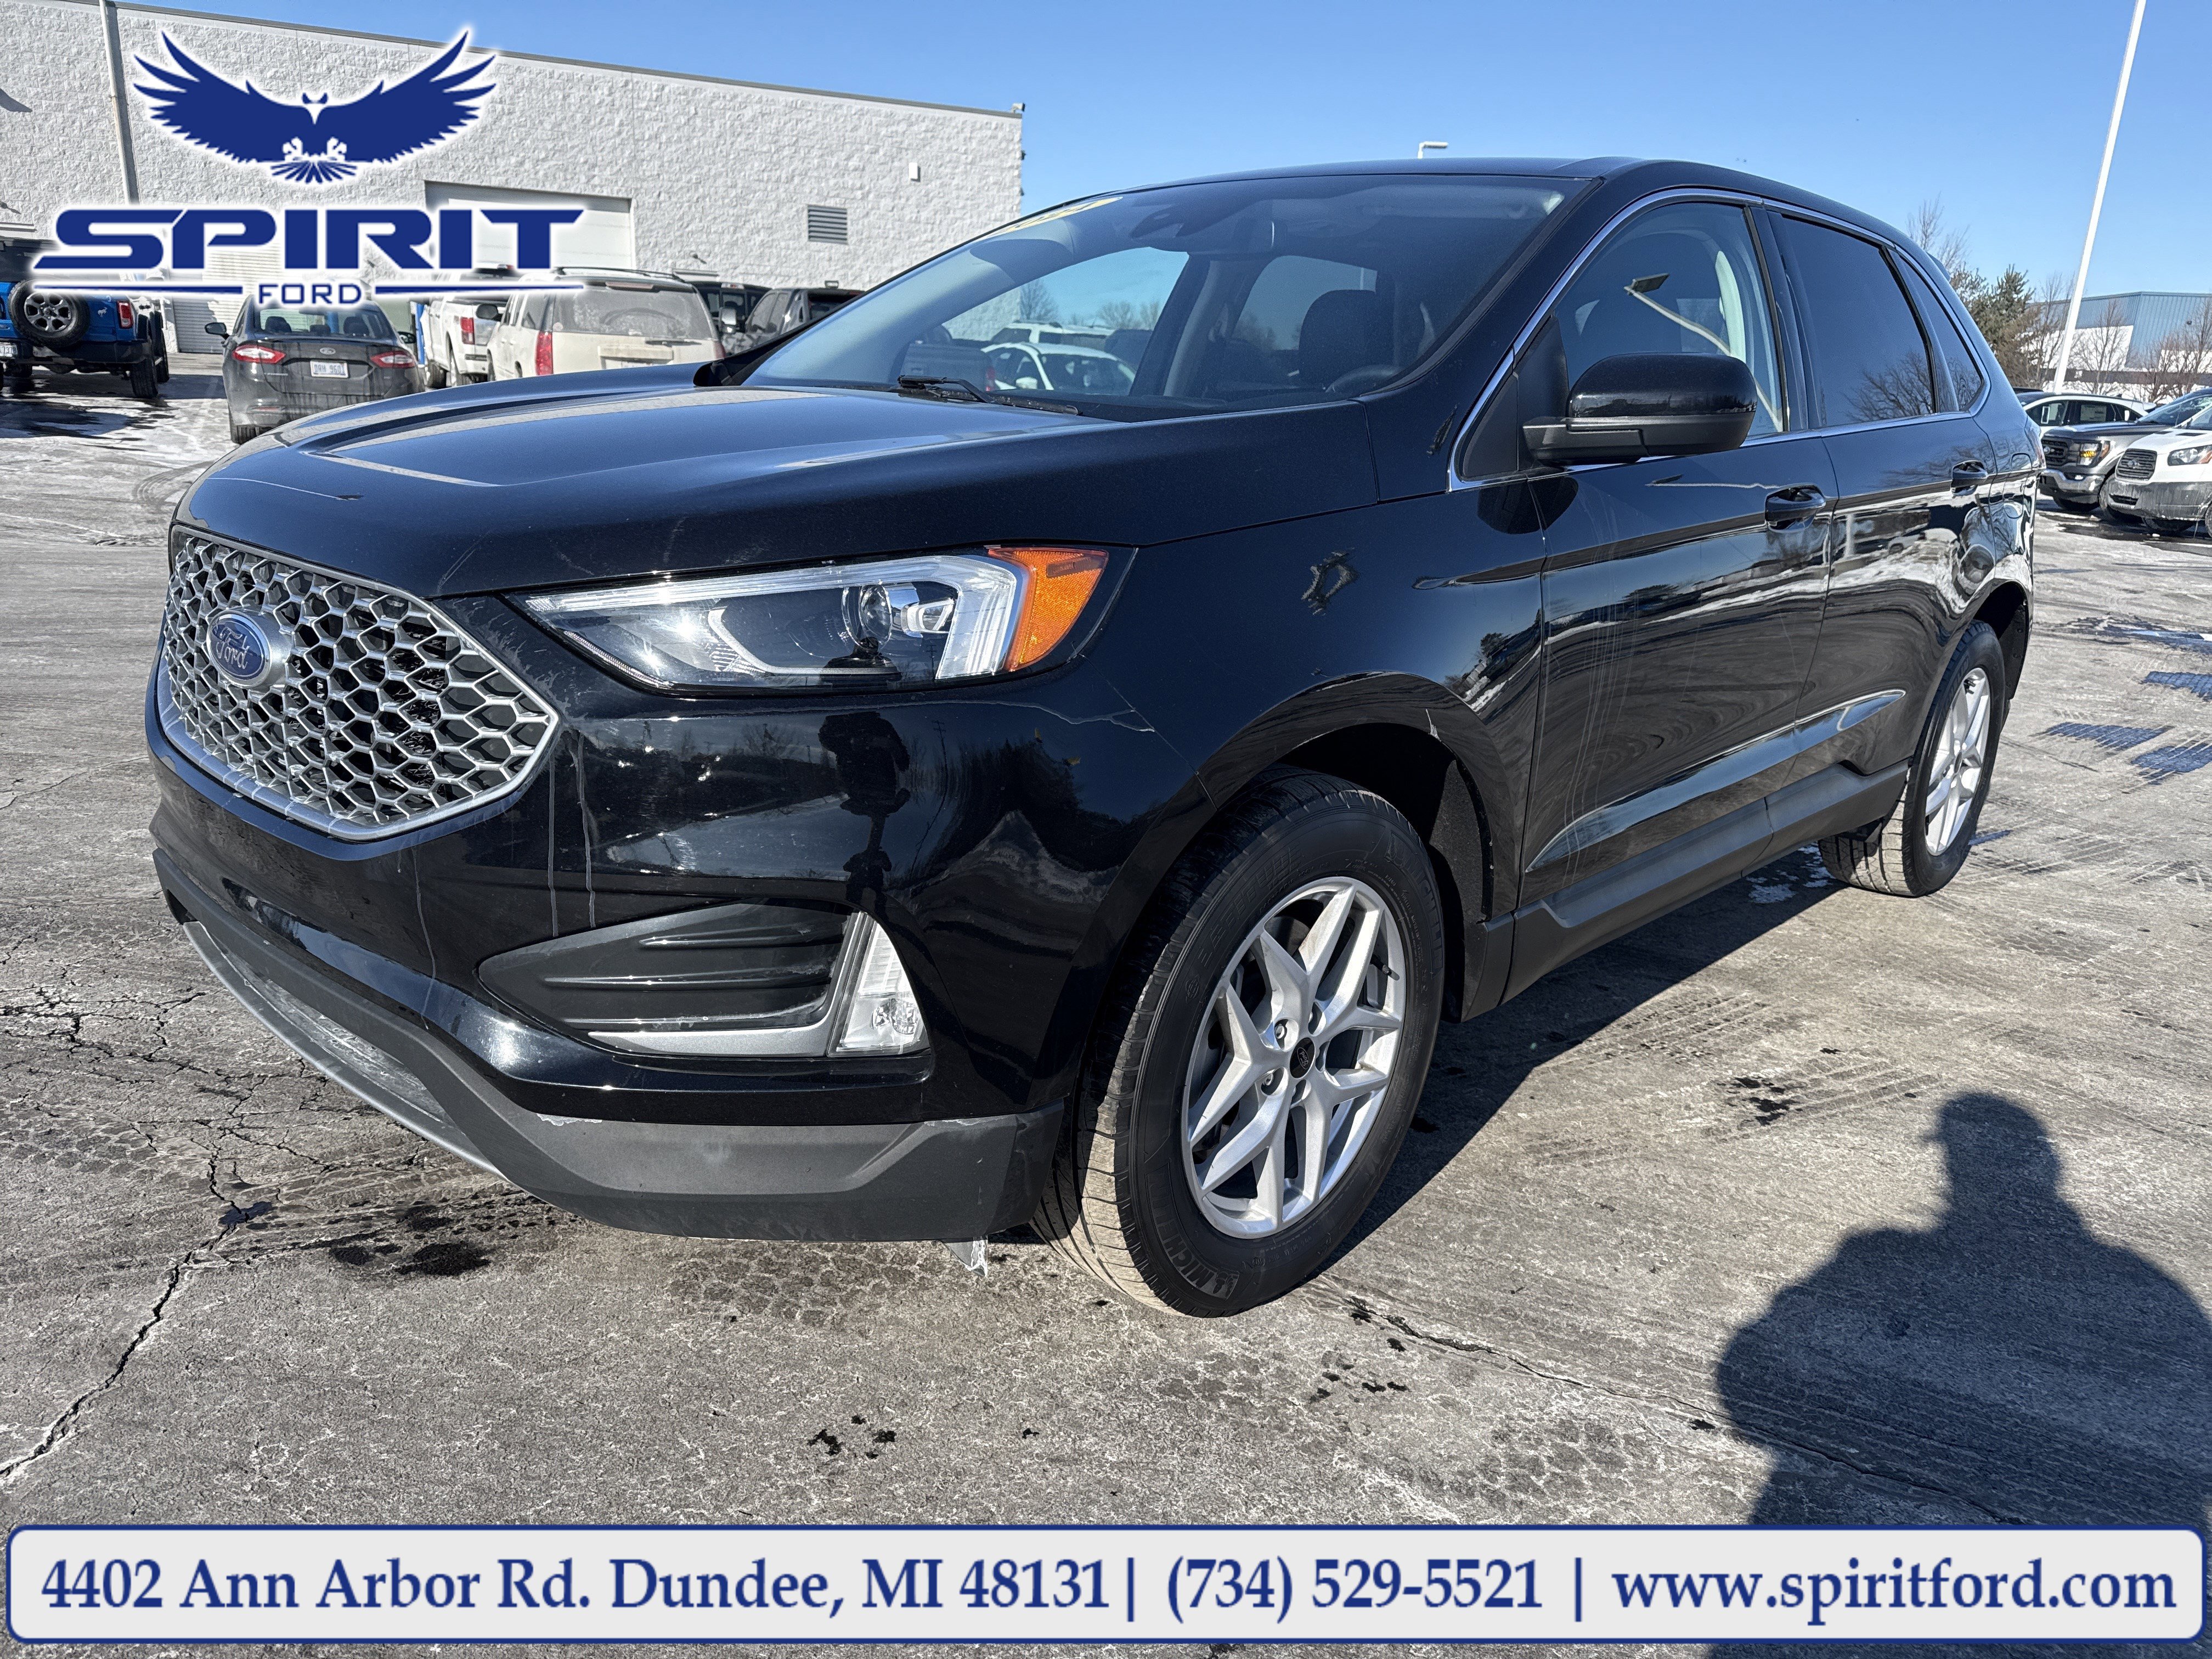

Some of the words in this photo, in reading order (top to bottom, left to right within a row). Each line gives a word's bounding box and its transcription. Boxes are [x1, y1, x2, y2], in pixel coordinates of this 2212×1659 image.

[216, 627, 250, 670] Ford
[1299, 1050, 1309, 1066] Ford
[1149, 1181, 1216, 1288] MICHELIN
